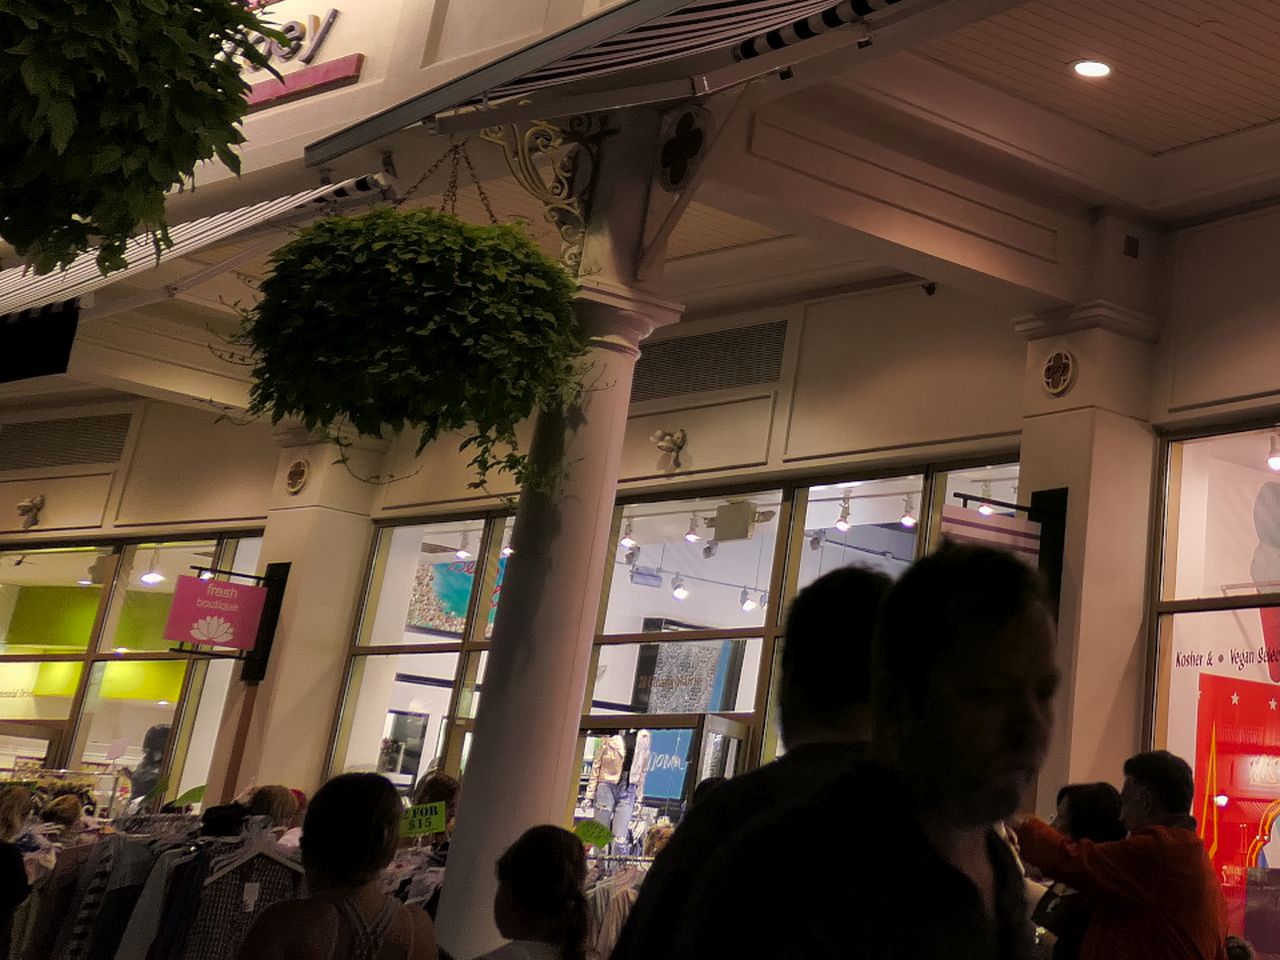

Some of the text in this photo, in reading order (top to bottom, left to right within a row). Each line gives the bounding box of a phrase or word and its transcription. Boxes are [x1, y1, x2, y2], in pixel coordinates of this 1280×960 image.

[207, 583, 238, 599] fresh
[196, 599, 240, 612] boutique
[1175, 651, 1204, 668] Kosher
[1206, 650, 1214, 667] &
[1229, 648, 1254, 672] Vegan
[412, 805, 439, 819] FOR
